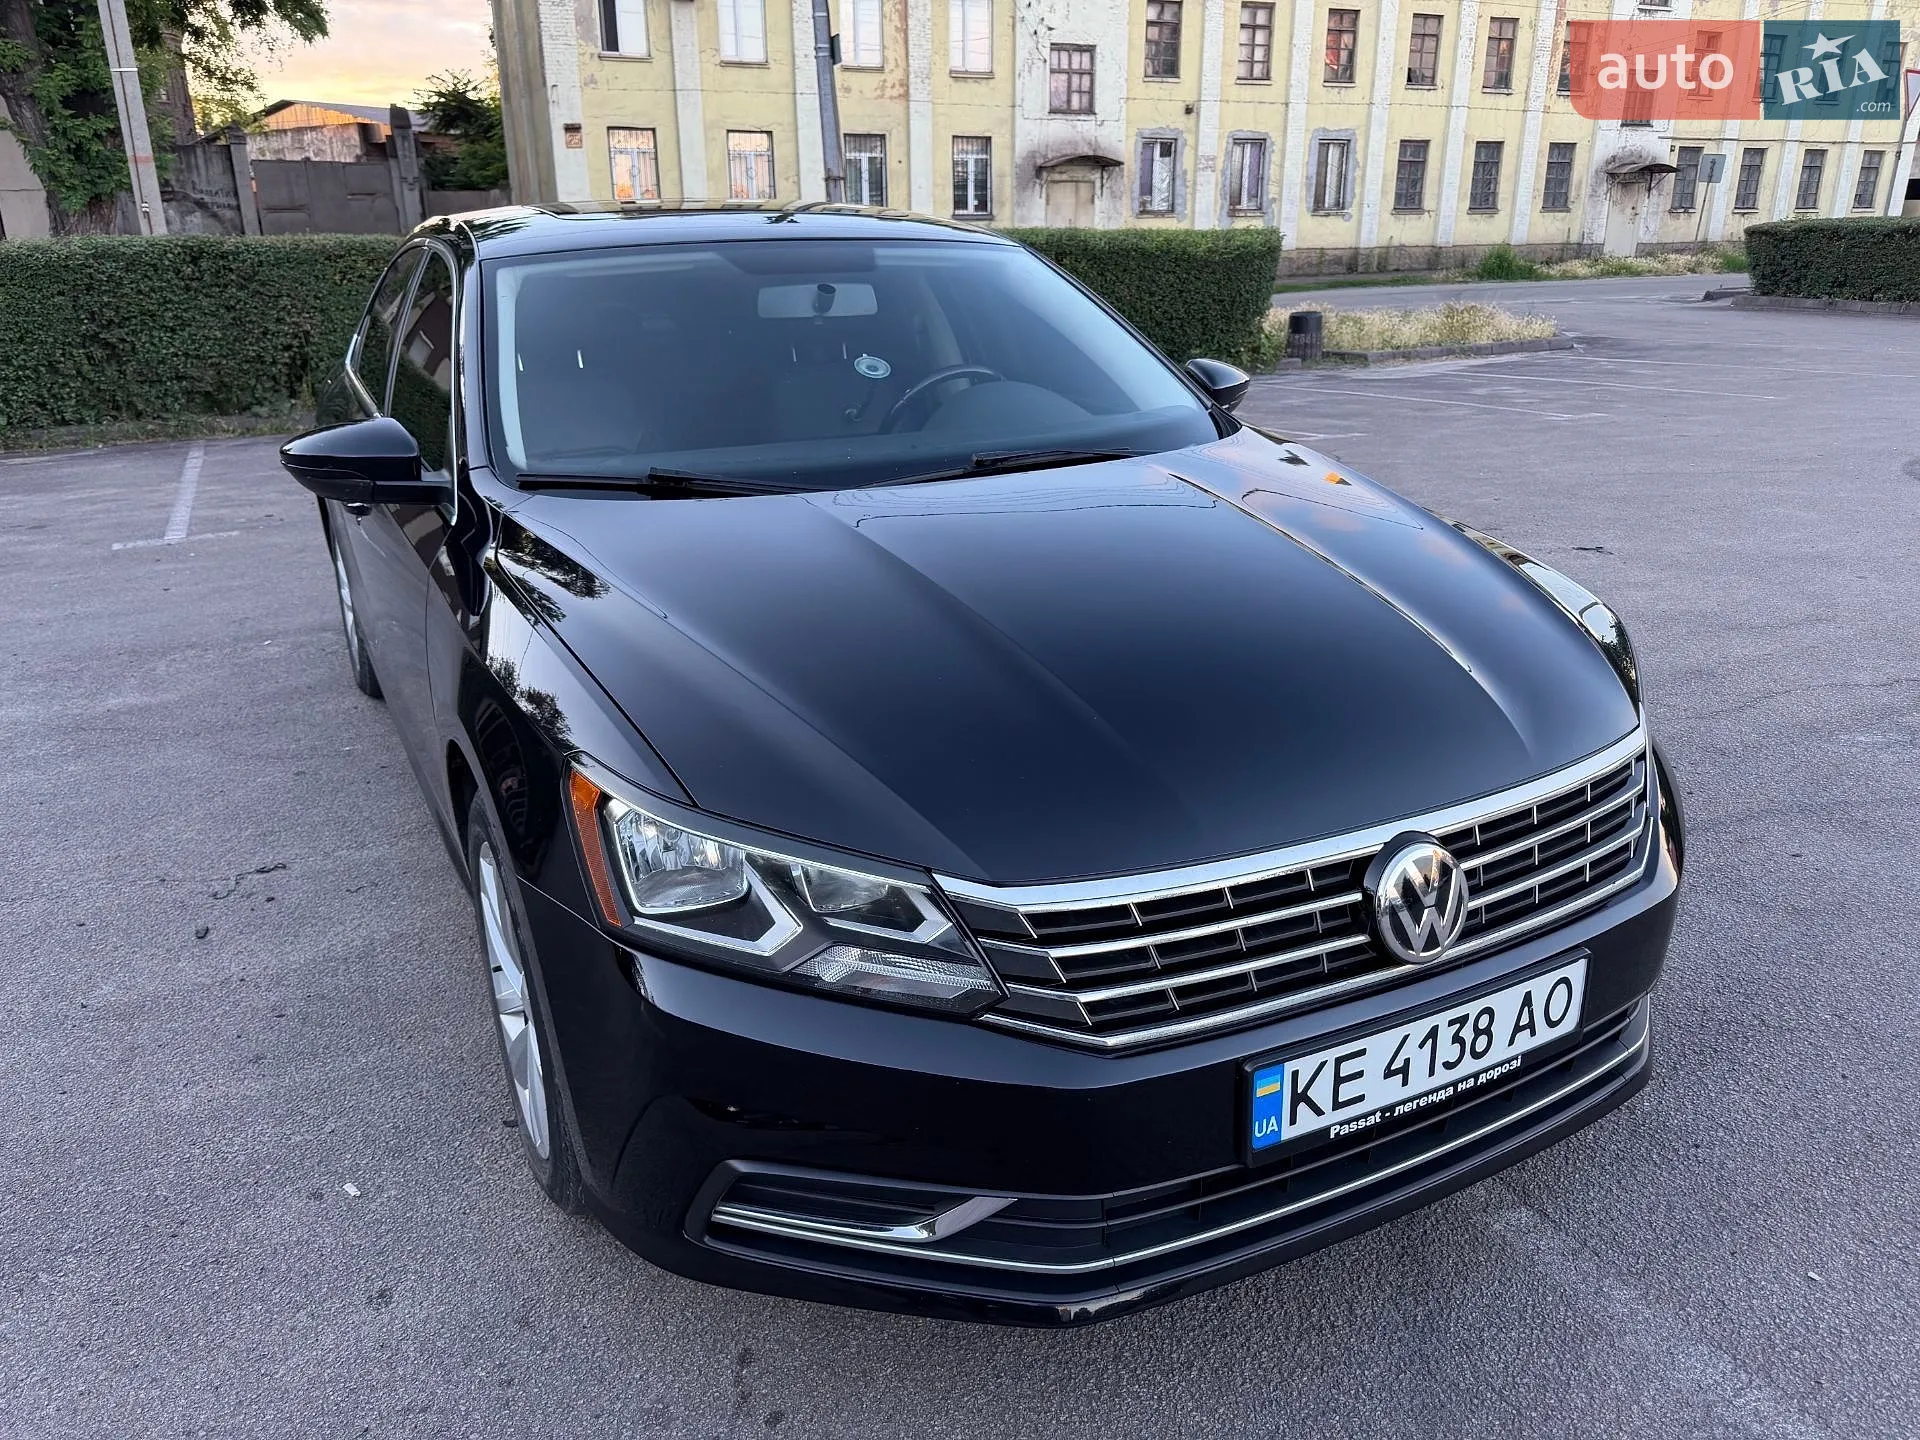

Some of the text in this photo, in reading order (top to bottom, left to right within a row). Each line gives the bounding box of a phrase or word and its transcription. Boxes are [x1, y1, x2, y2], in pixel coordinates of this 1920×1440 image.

[1289, 976, 1573, 1127] KE 4138 AO
[1254, 1115, 1279, 1138] UA
[1329, 1110, 1382, 1139] Passat
[1393, 1086, 1453, 1117] легенда
[1457, 1076, 1475, 1092] на
